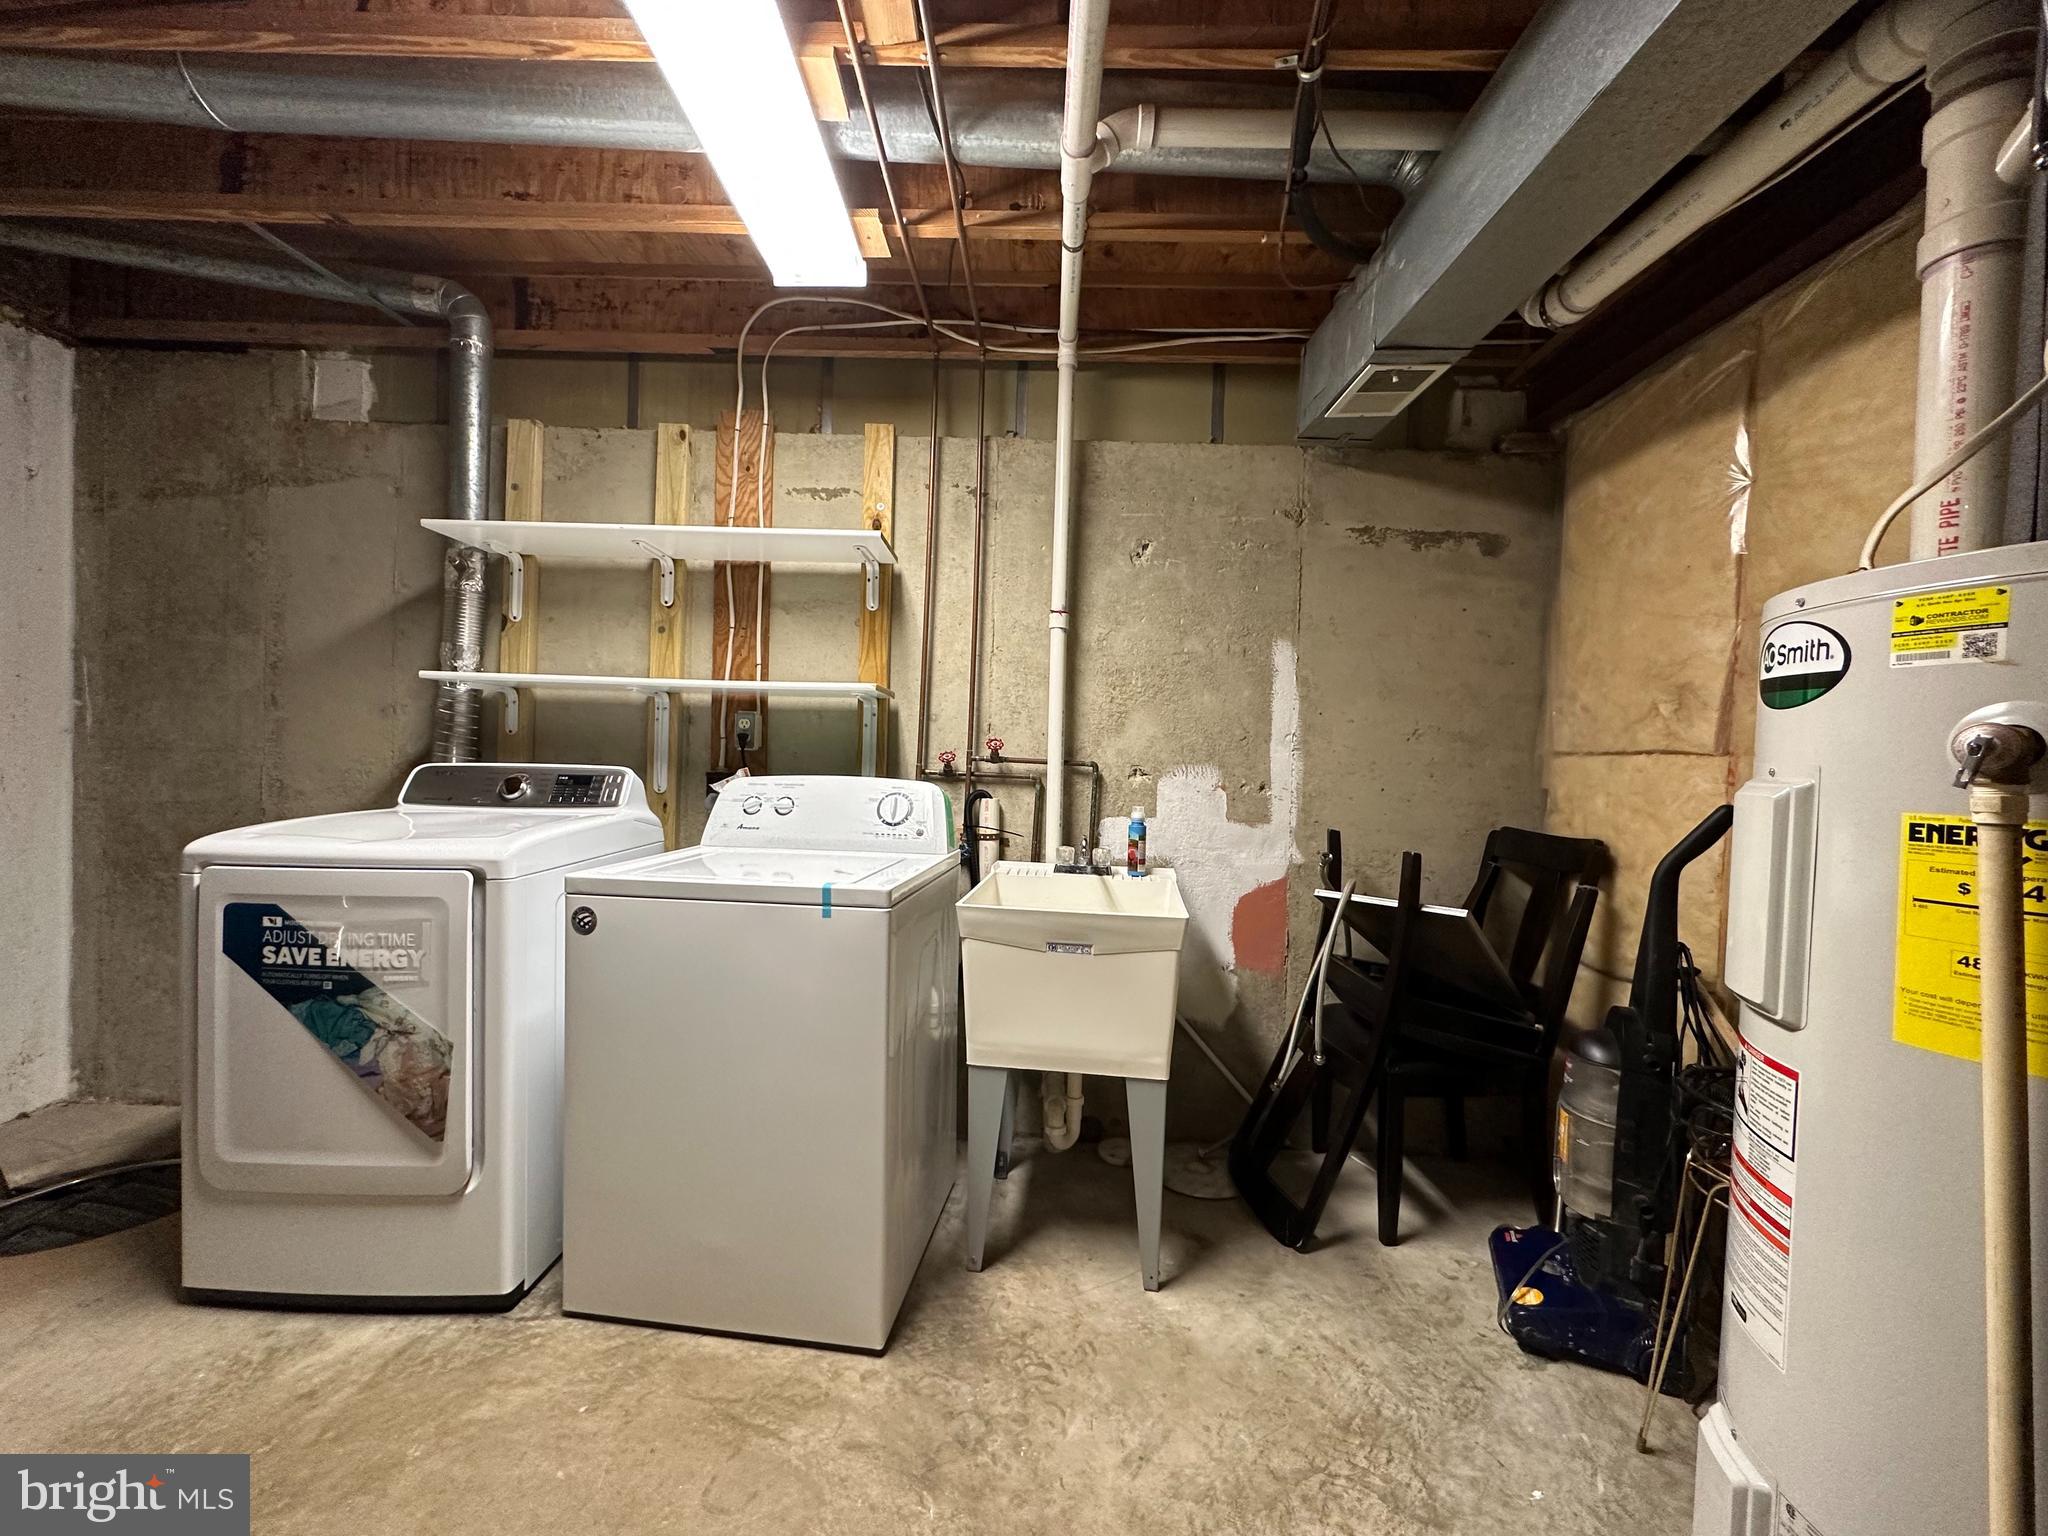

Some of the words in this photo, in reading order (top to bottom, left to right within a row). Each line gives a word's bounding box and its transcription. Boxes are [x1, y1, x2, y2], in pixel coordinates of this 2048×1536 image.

[1938, 498, 1961, 528] PIPE
[1926, 608, 1989, 620] CONTRACTOR
[1777, 637, 1830, 666] Smith
[1929, 865, 1976, 877] Estimated
[1957, 882, 1972, 897] $
[262, 929, 314, 945] ADJUST
[377, 932, 417, 947] TIME
[262, 945, 321, 966] SAVE
[326, 947, 427, 970] ENERGY
[1900, 986, 1918, 994] Your
[1920, 991, 1937, 1000] cost
